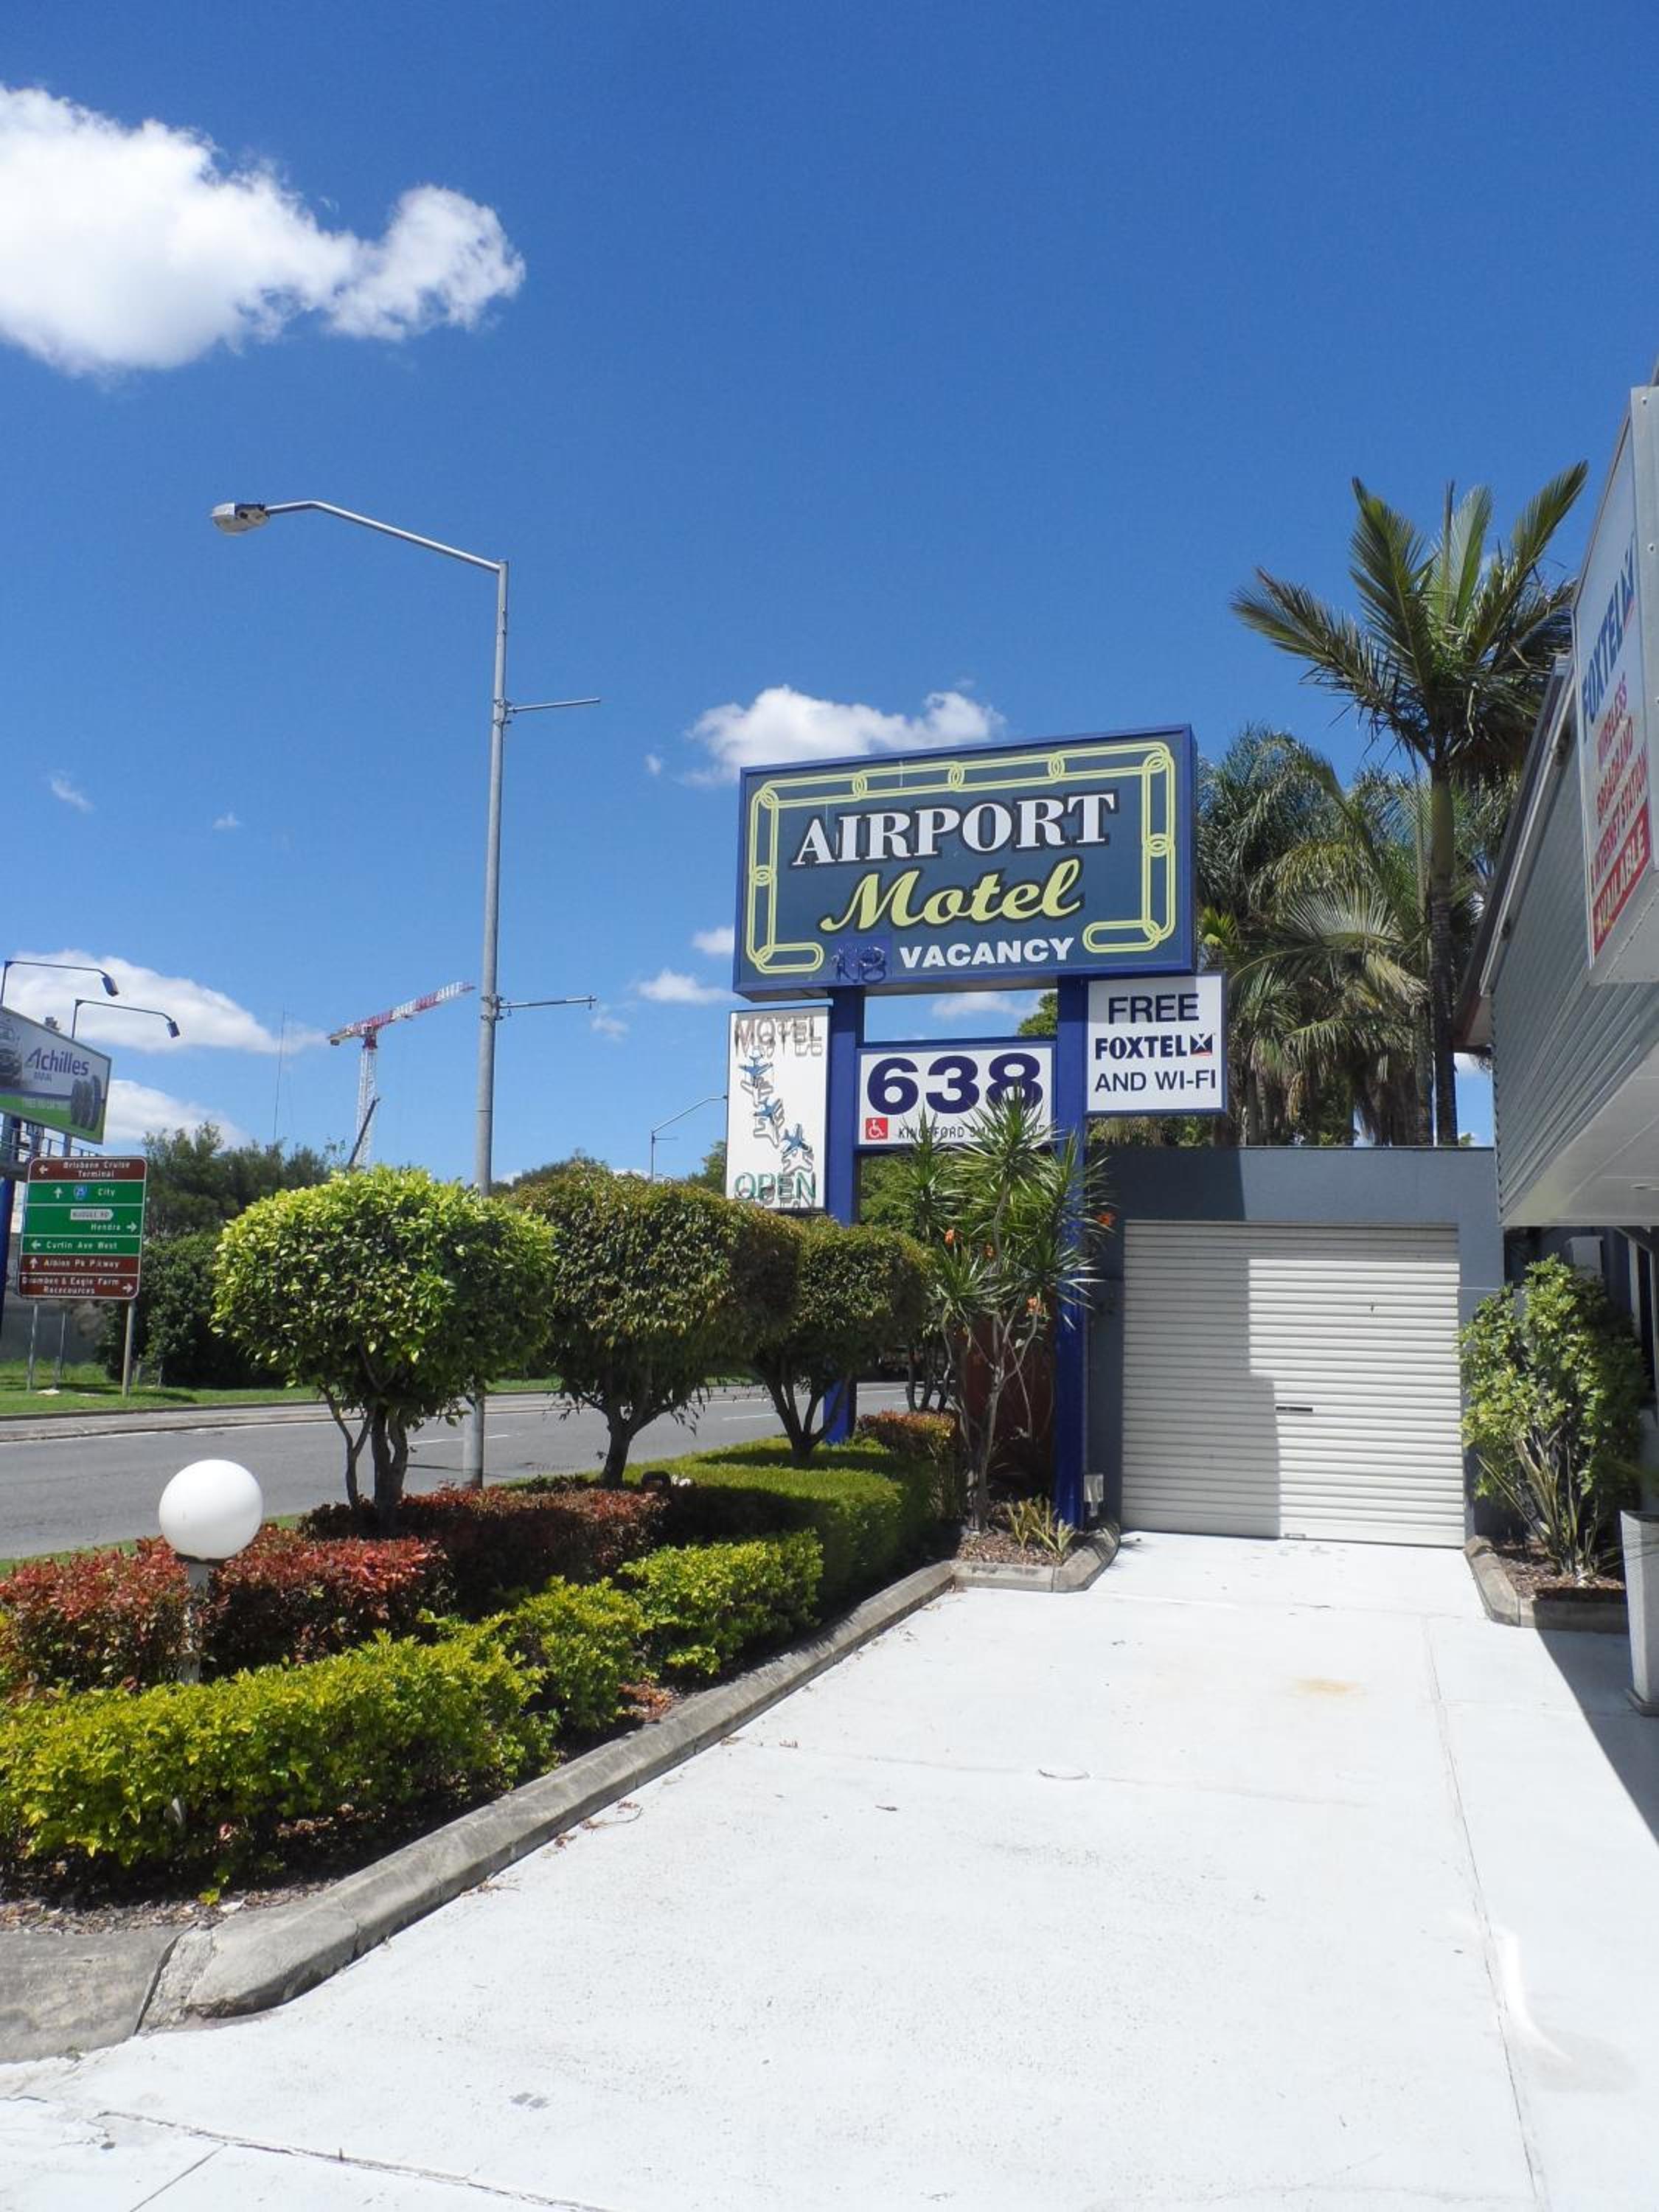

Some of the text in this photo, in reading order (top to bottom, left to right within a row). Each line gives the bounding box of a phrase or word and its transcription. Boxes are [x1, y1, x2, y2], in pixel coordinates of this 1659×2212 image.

[1582, 580, 1623, 744] FOXTEL
[791, 793, 1116, 866] AIRPORT
[819, 858, 1082, 933] Motel
[898, 937, 1074, 968] VACANCY
[1108, 993, 1200, 1025] FREE
[27, 1047, 90, 1077] Achilles
[1095, 1034, 1187, 1060] FOXTEL
[866, 1052, 1043, 1116] 638
[1095, 1069, 1216, 1092] AND WI-FI
[104, 1161, 131, 1169] Cruise
[97, 1187, 116, 1197] City
[734, 1172, 816, 1201] OPEN
[46, 1241, 118, 1250] Curtin Ave West
